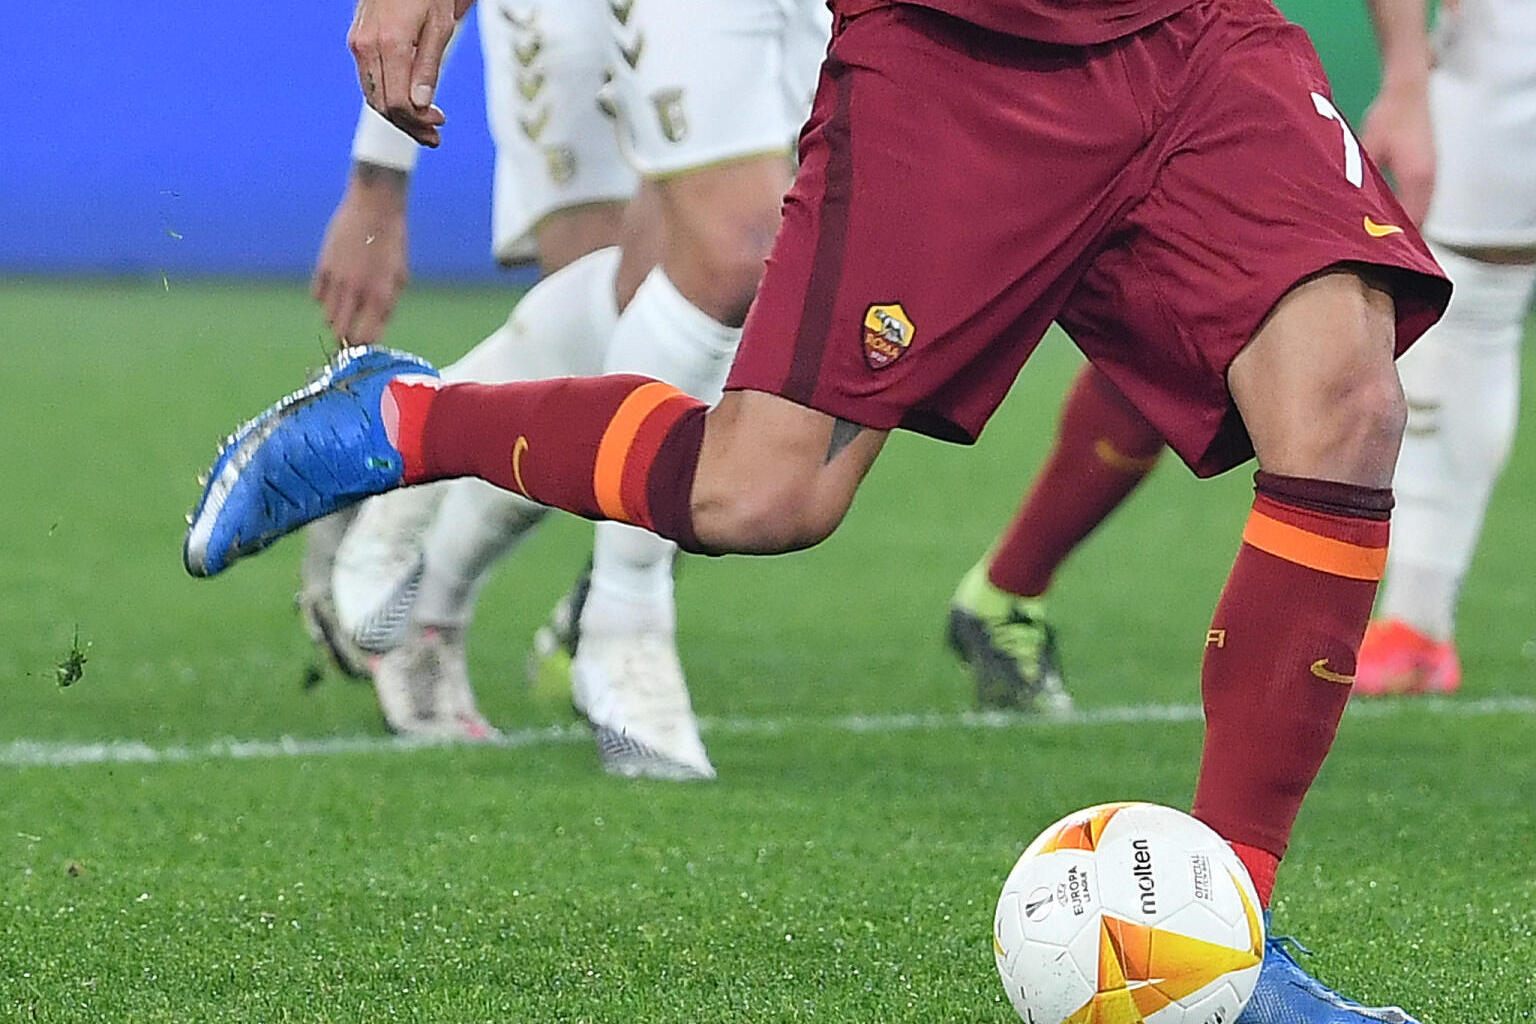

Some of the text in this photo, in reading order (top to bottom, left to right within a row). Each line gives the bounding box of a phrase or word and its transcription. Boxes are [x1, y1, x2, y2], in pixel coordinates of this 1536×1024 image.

[1310, 91, 1363, 189] 7
[1068, 865, 1084, 916] EUROPA
[1132, 838, 1157, 915] molten
